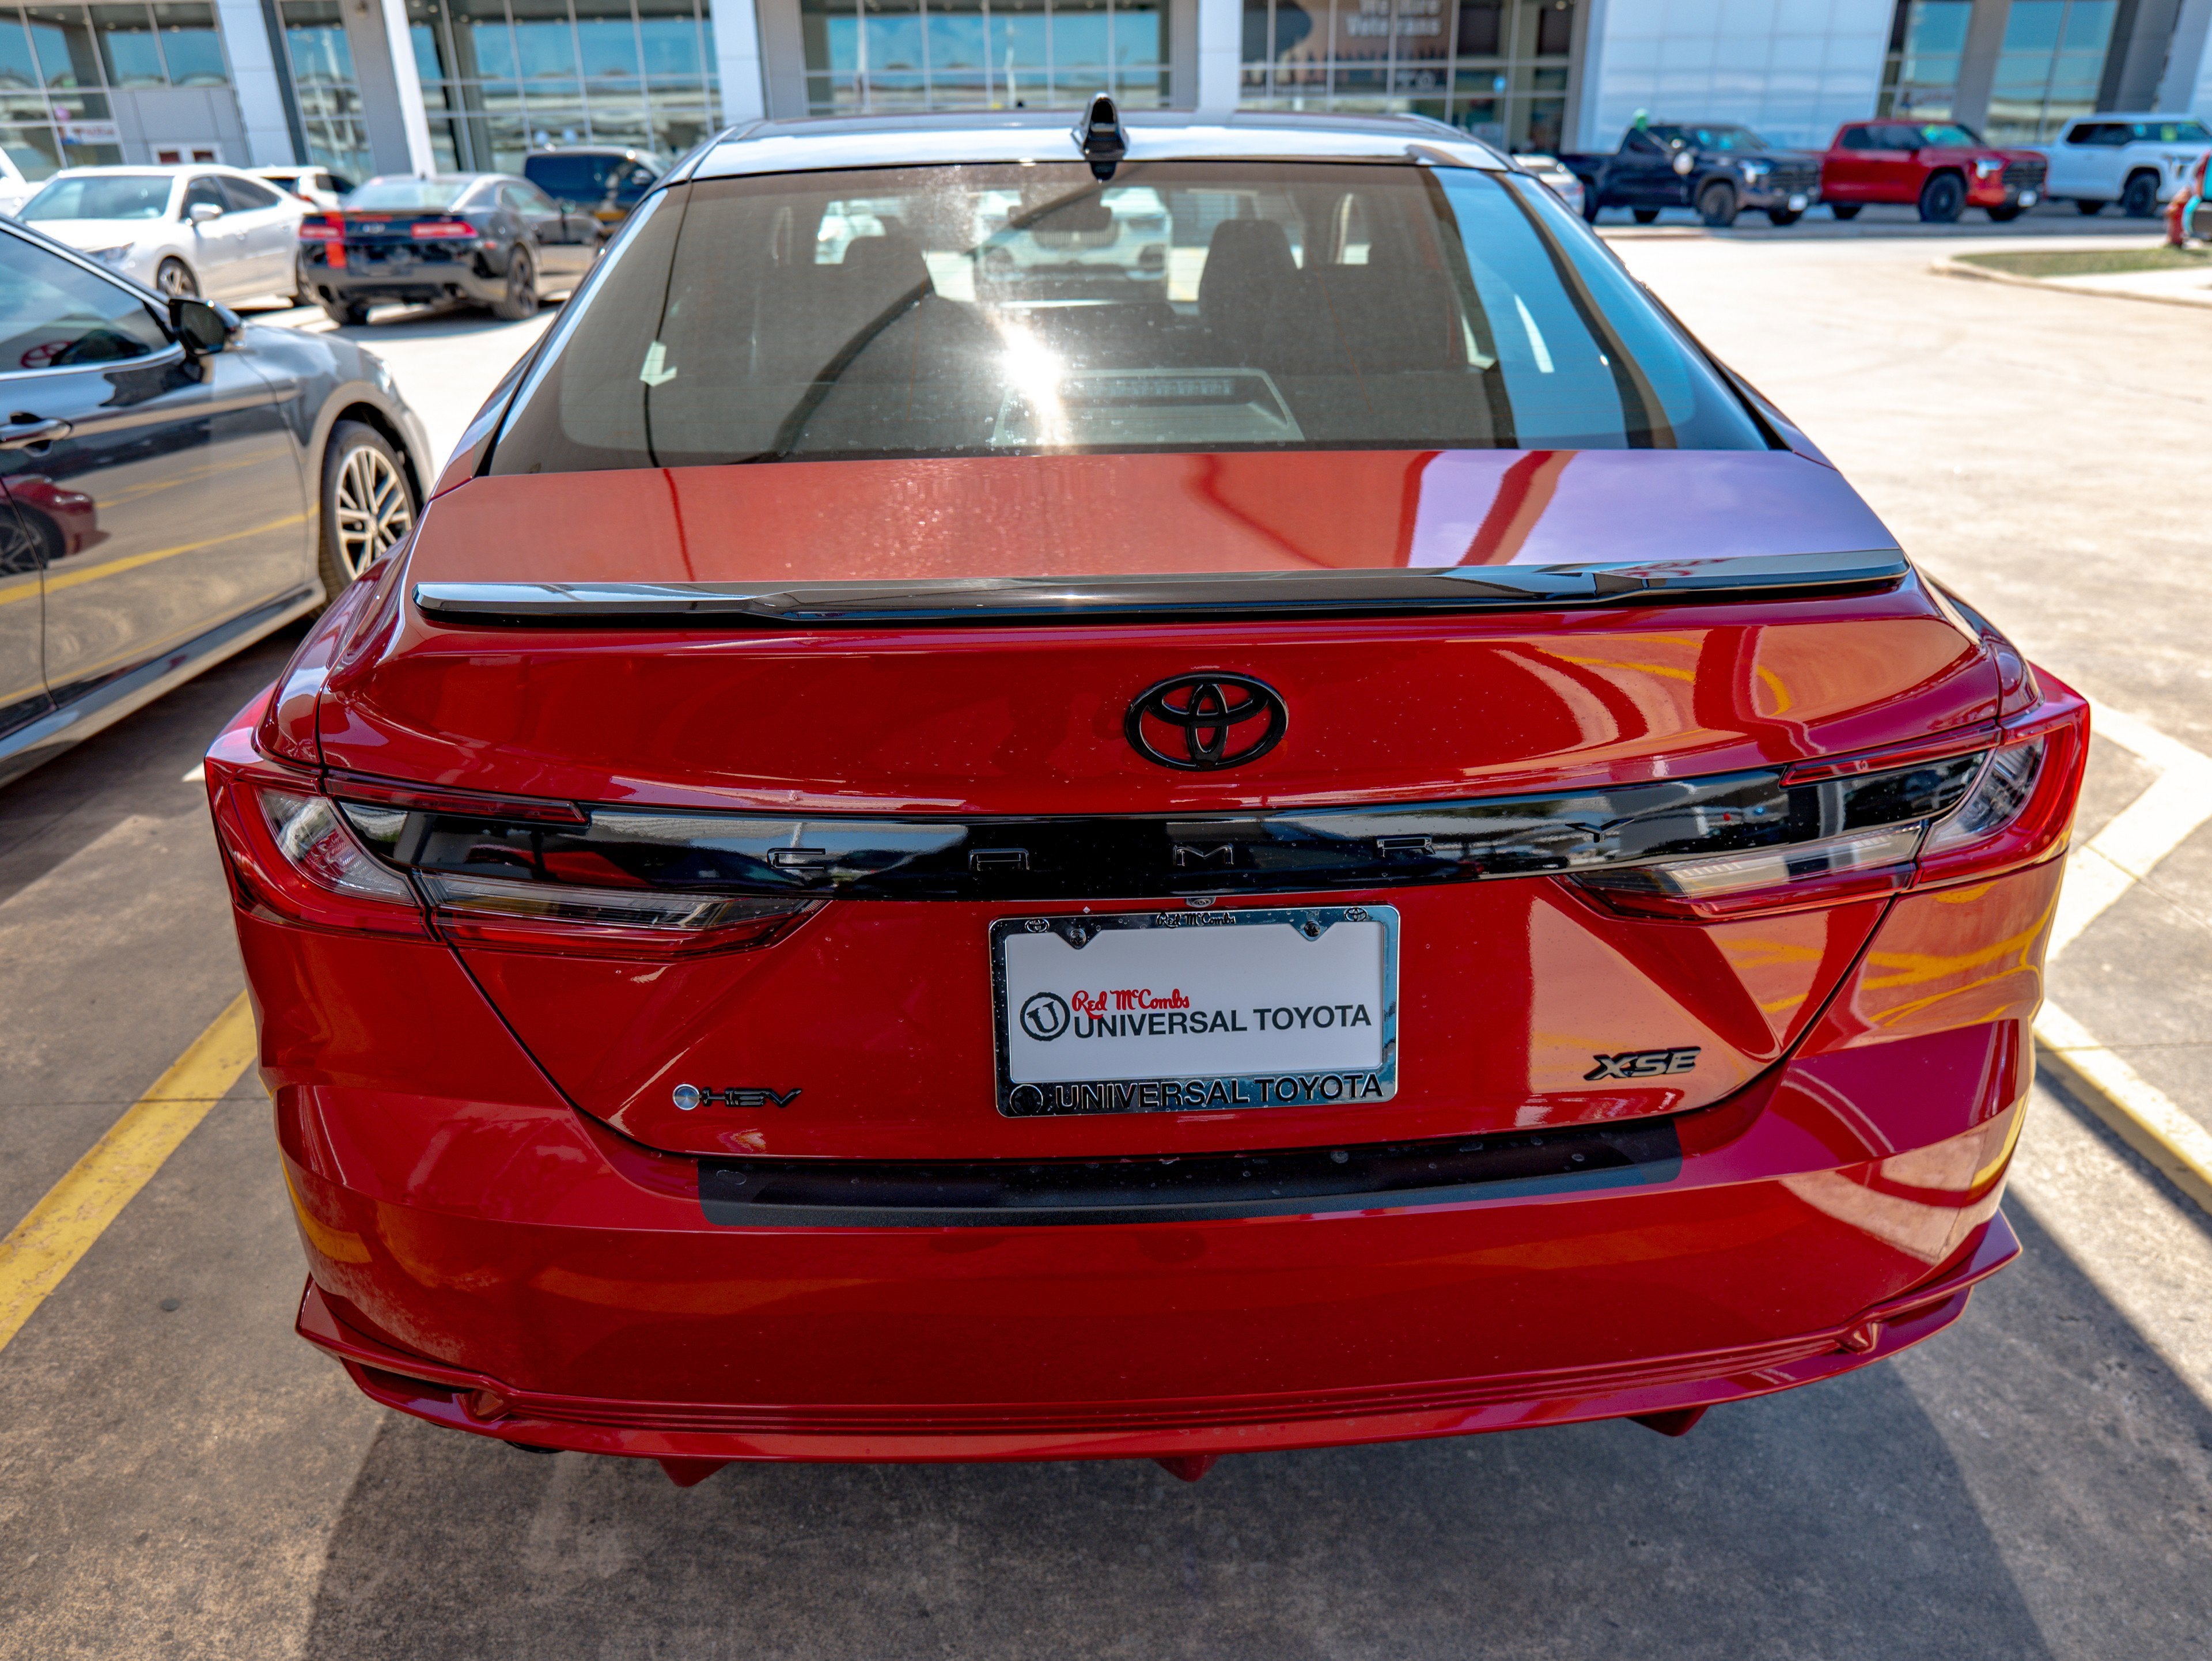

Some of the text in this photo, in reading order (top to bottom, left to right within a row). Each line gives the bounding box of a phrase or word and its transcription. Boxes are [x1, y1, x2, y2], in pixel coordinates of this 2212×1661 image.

[767, 818, 1635, 872] CAMRY
[1156, 912, 1236, 928] Red McCombs
[1071, 988, 1190, 1020] Red McCombs
[1074, 1004, 1372, 1038] UNIVERSAL TOYOTA
[1583, 1046, 1702, 1081] XSE
[701, 1087, 802, 1107] HEV
[1055, 1072, 1384, 1110] UNIVERSAL TOYOTA
